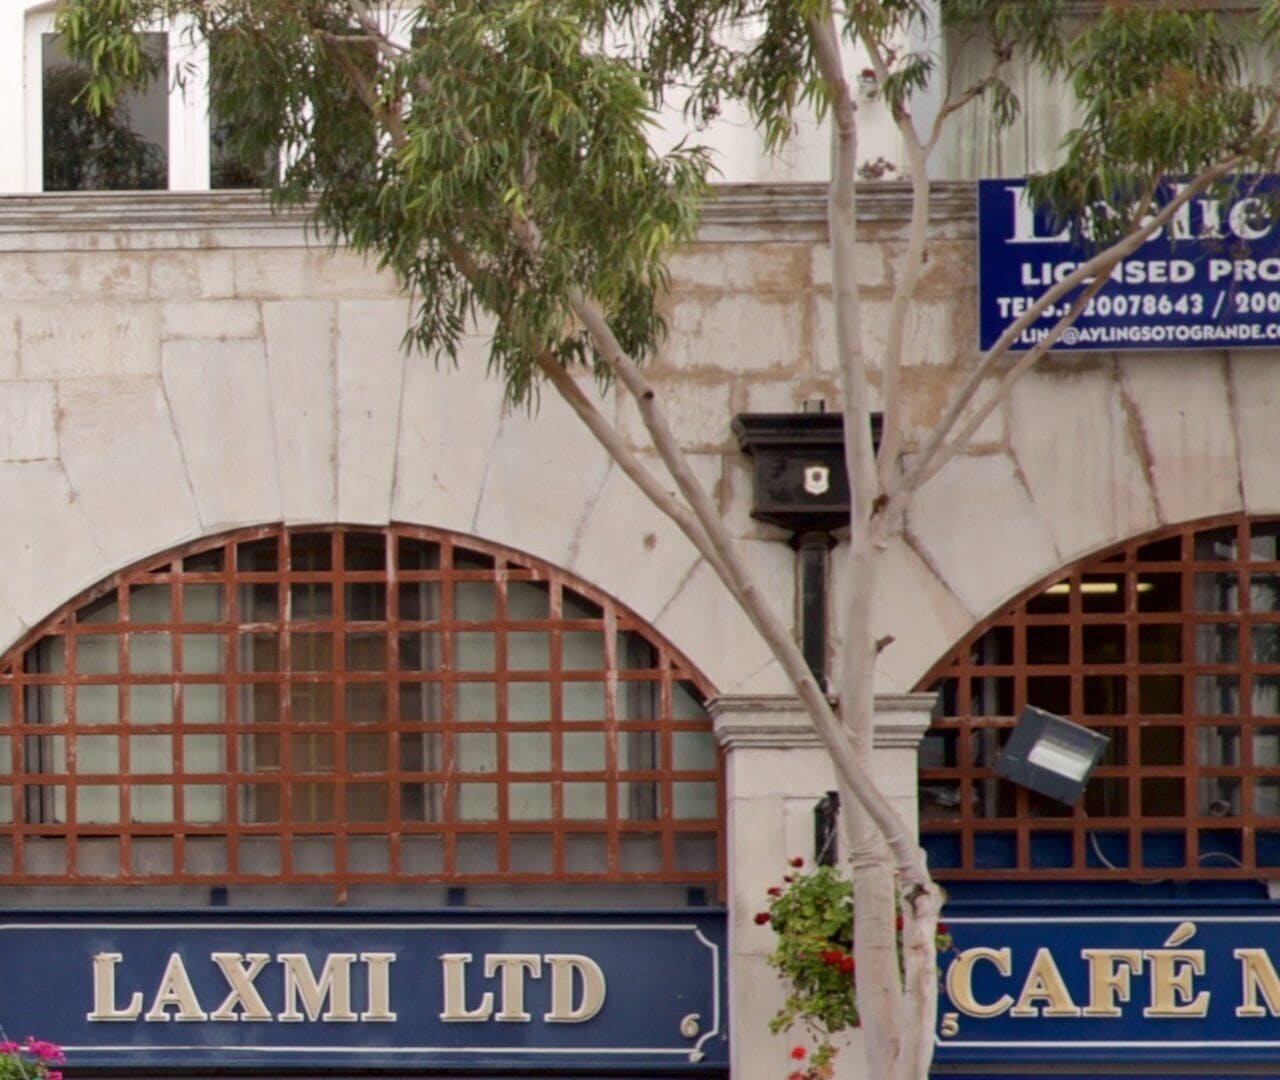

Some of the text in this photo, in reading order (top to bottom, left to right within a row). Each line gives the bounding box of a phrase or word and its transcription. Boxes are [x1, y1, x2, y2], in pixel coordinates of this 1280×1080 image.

[1209, 257, 1280, 283] PRO
[1211, 290, 1226, 319] /
[946, 921, 1211, 1018] CAFÉ
[87, 952, 607, 1024] LAXMI LTD
[680, 1013, 701, 1038] 6
[940, 1012, 960, 1038] 5
